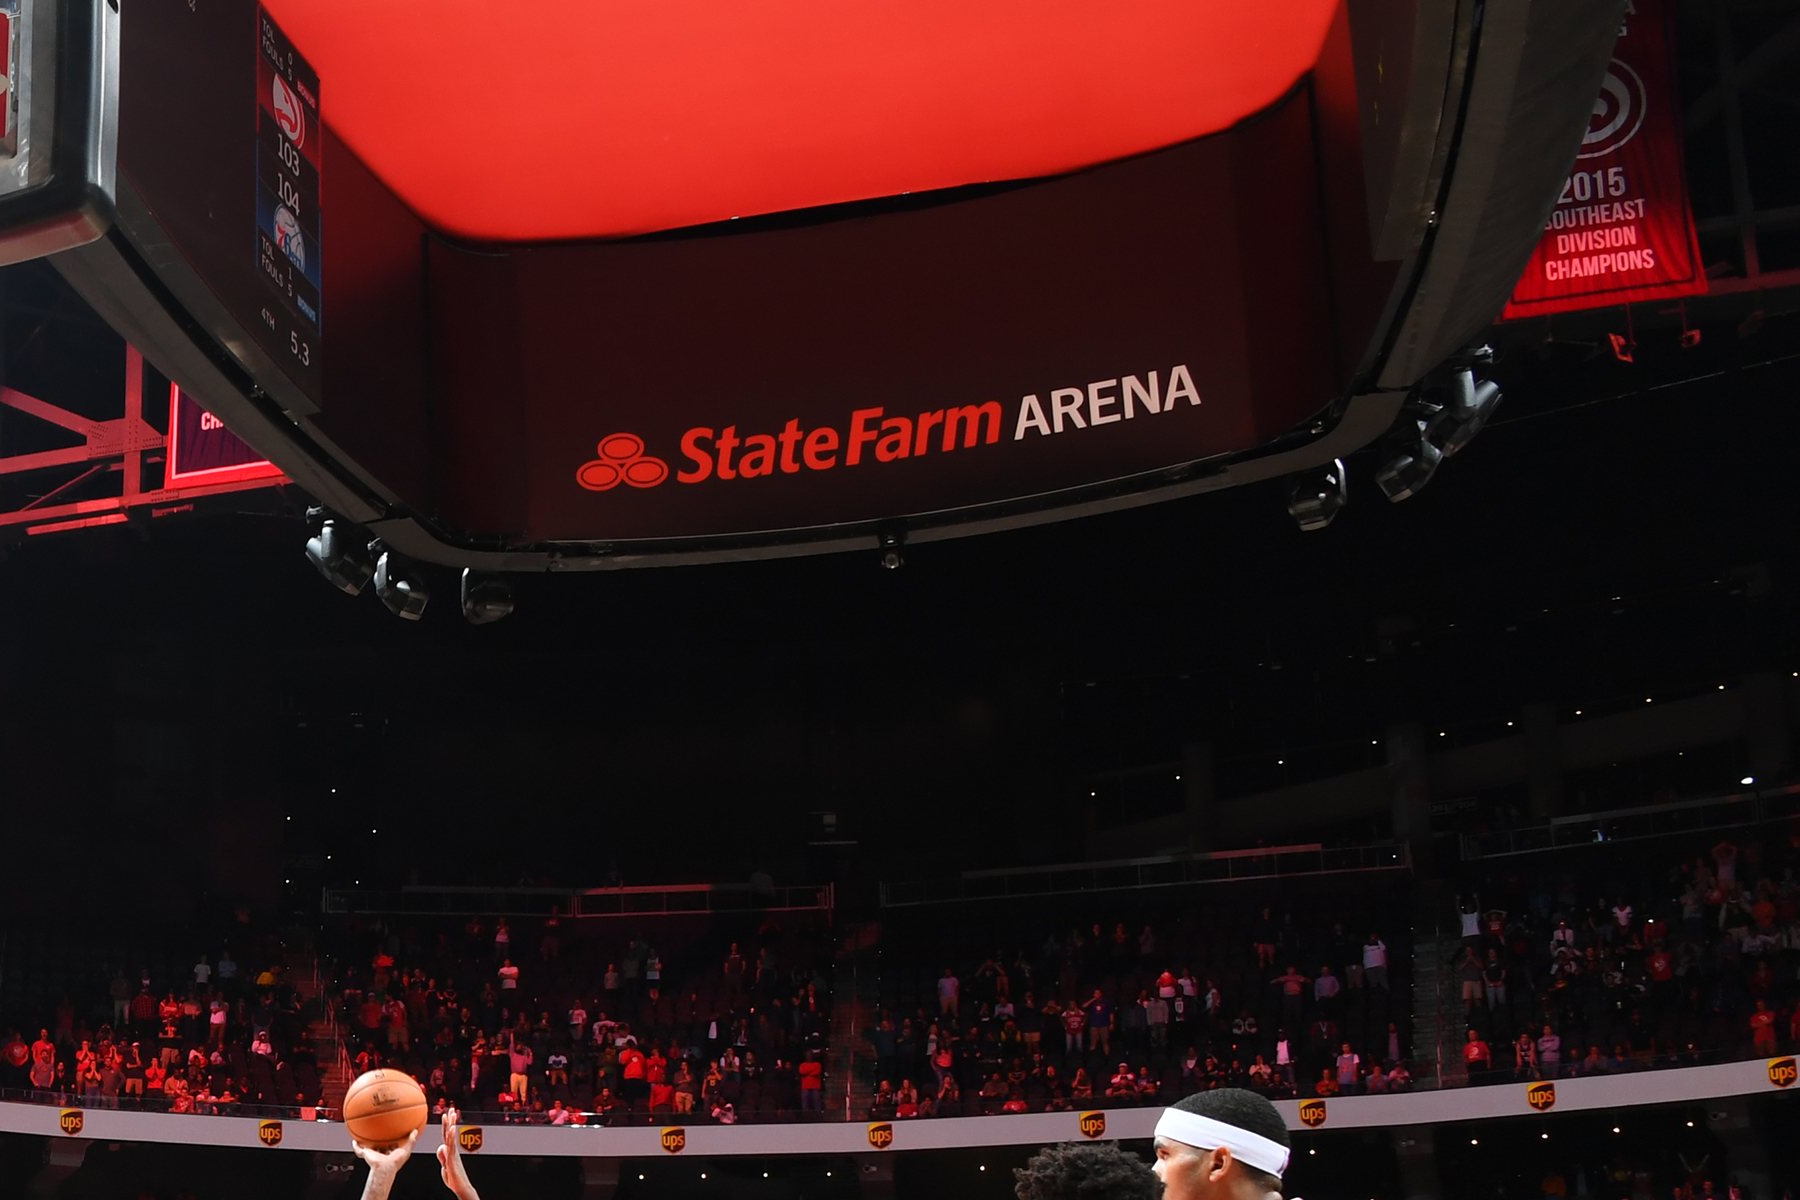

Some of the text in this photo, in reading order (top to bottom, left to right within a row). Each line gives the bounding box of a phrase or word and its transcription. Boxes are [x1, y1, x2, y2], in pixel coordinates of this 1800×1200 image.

[262, 19, 274, 43] TOL
[262, 36, 283, 70] FOULS
[278, 134, 299, 176] 103
[278, 173, 300, 216] 104
[1557, 167, 1625, 204] 2015
[262, 236, 275, 260] TOL
[1557, 225, 1636, 255] DIVISION
[262, 256, 283, 287] FOULS
[1545, 249, 1654, 281] CHAMPIONS
[261, 307, 275, 330] 4TH
[291, 330, 309, 366] 5.3
[1014, 364, 1201, 440] ARENA
[1771, 1065, 1796, 1083] ups
[1529, 1090, 1551, 1107] ups
[62, 1116, 82, 1132] ups
[1081, 1118, 1102, 1134] ups
[1302, 1107, 1324, 1123] ups
[261, 1126, 281, 1142] ups
[460, 1131, 481, 1148] ups
[663, 1134, 683, 1150] ups
[870, 1129, 891, 1146] ups
